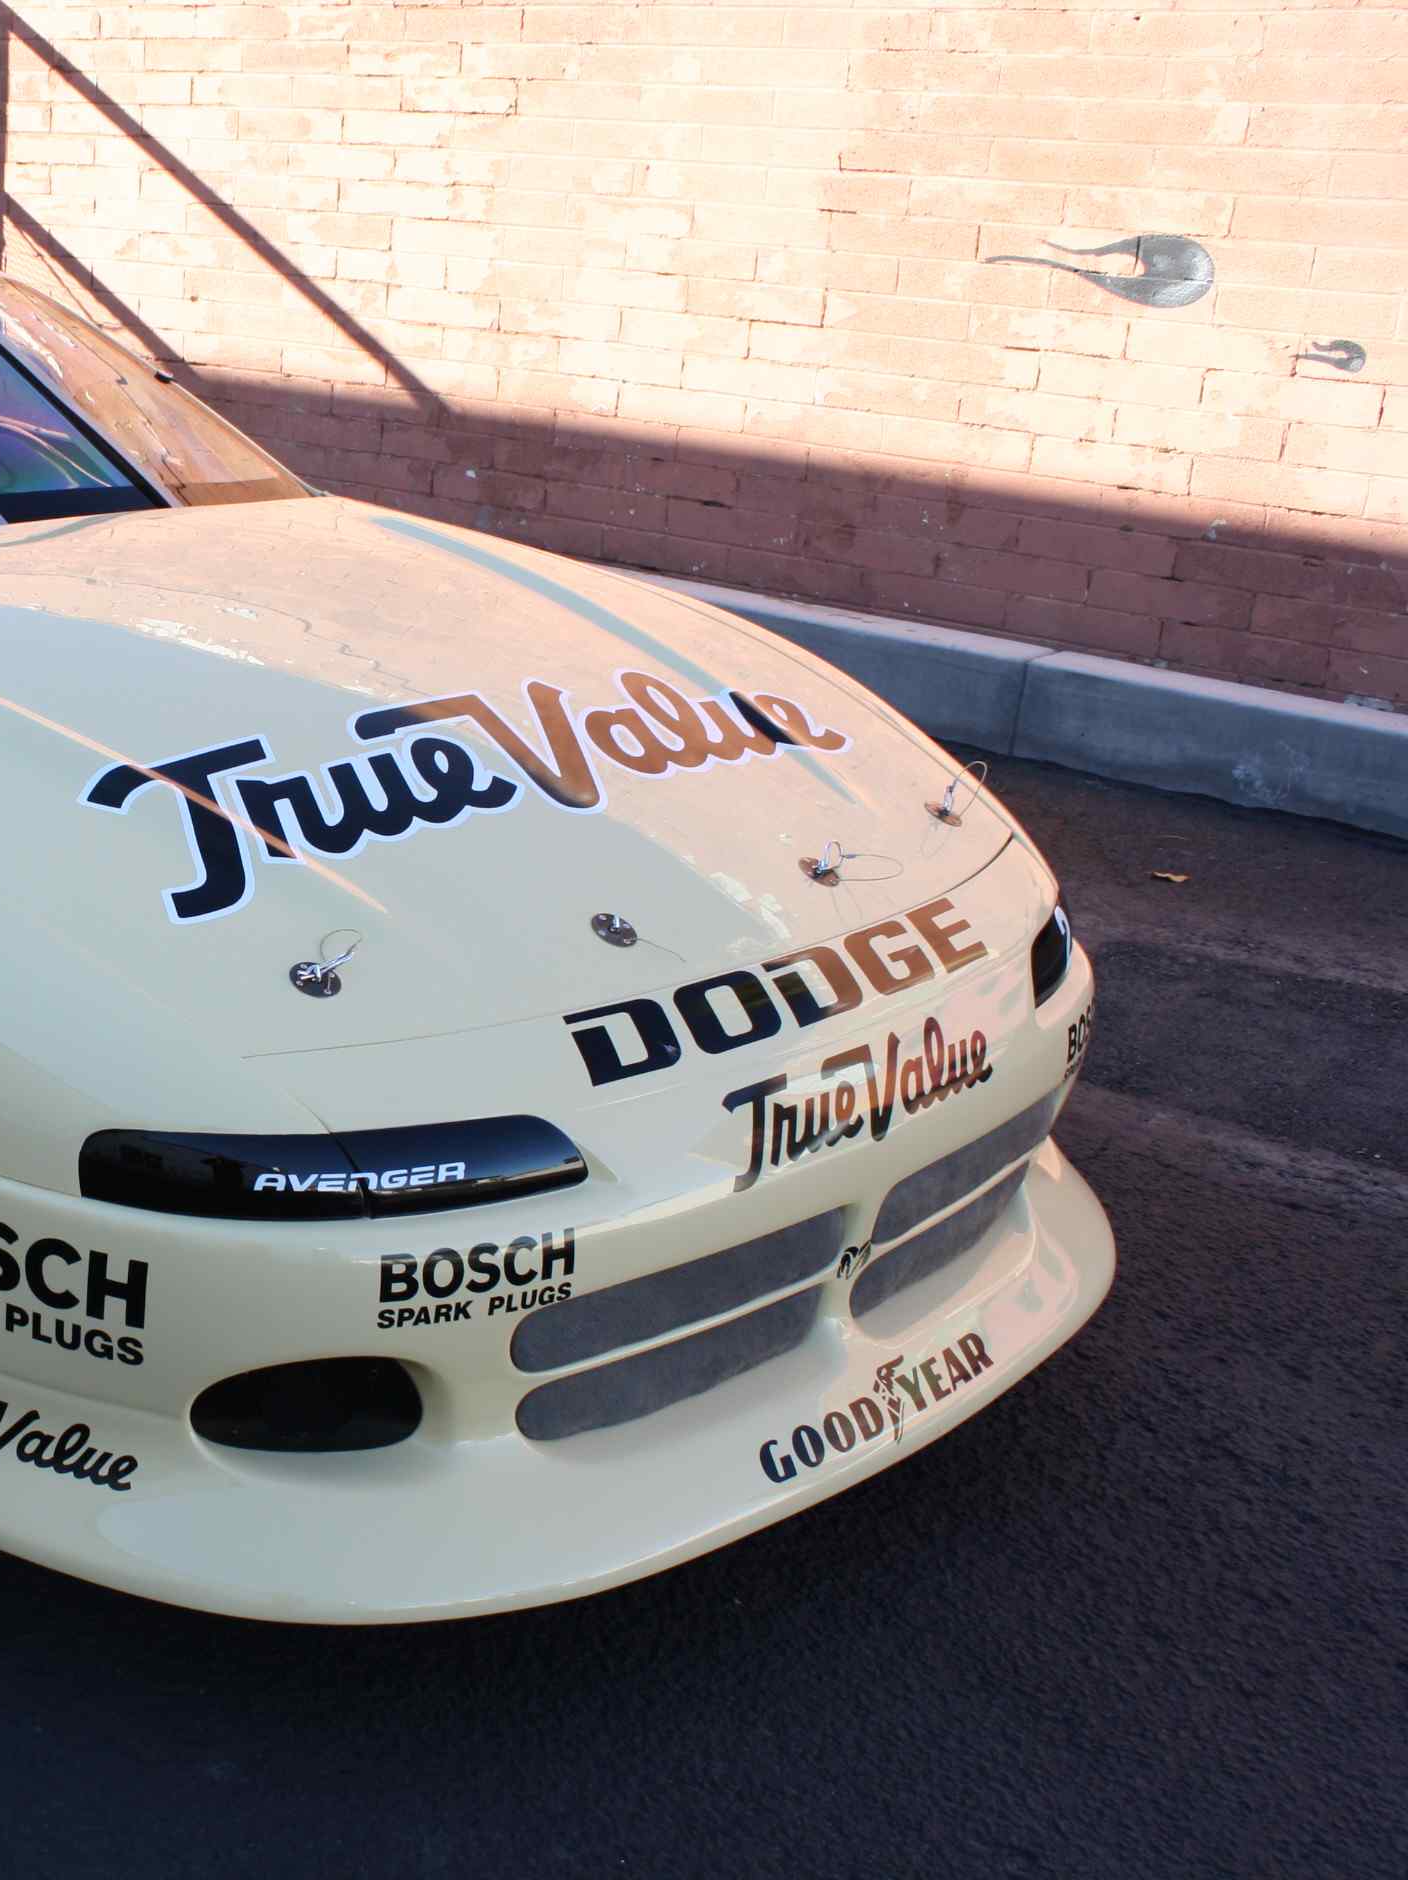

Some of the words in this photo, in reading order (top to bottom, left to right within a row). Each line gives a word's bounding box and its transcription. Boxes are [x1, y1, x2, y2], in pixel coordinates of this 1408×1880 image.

[562, 897, 988, 1087] DODGE
[253, 1161, 466, 1193] AVENGER
[378, 1227, 576, 1304] BOSCH
[376, 1301, 473, 1330] SPARK
[487, 1281, 573, 1318] PLUGS
[4, 1307, 144, 1367] PLUGS
